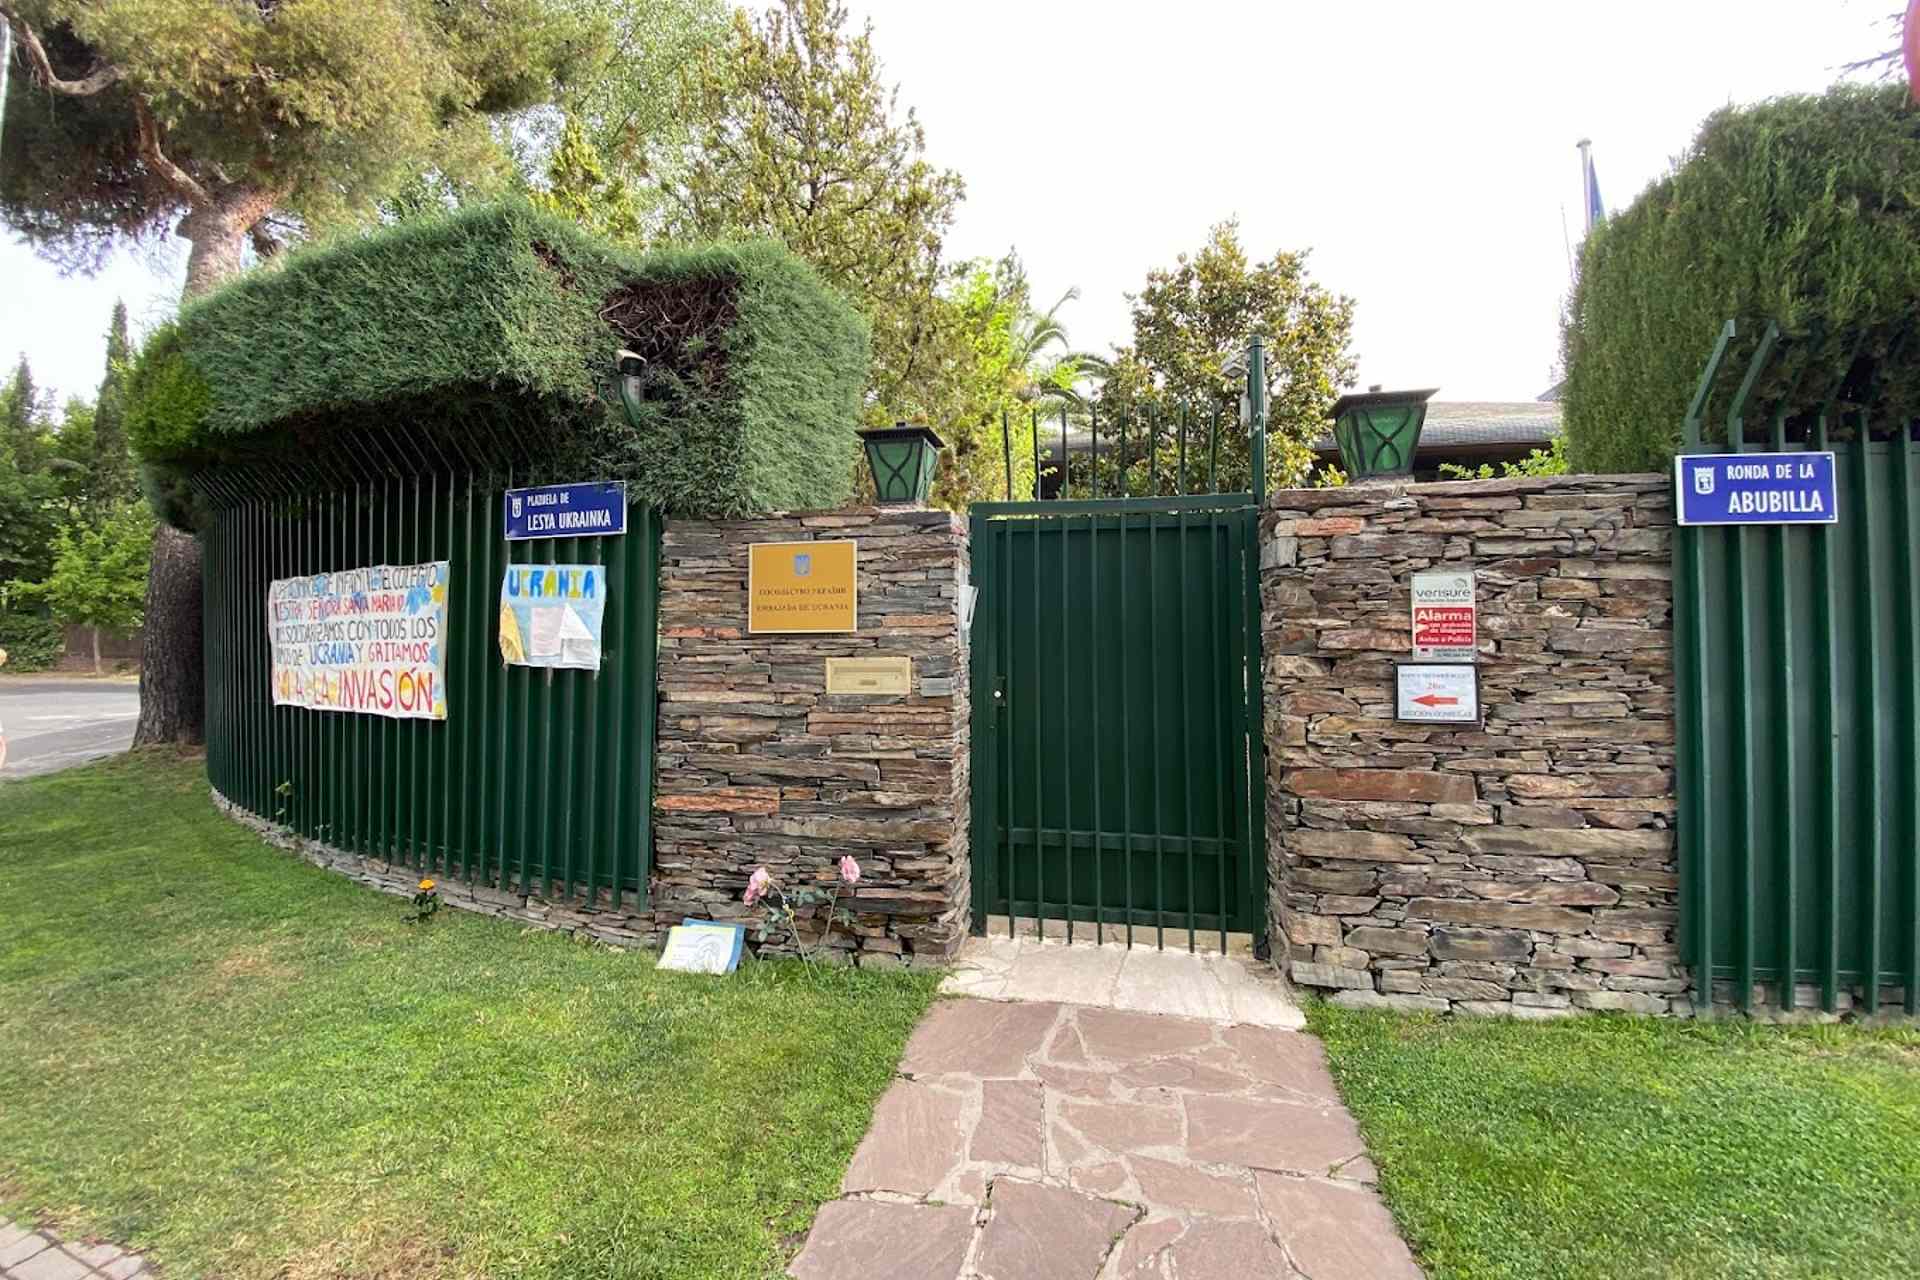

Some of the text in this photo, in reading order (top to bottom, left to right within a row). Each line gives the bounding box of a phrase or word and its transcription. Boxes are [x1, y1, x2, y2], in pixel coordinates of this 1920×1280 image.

[1727, 464, 1815, 480] RONDA DE LA
[527, 491, 569, 507] PLAZUELA DE
[1728, 490, 1824, 513] ABUBILLA
[527, 509, 612, 531] LESYA UKRAINKA
[508, 569, 595, 599] UCRANIA
[1416, 588, 1471, 598] verisure
[1417, 609, 1472, 621] Alarma
[347, 620, 372, 641] CON
[375, 619, 407, 641] TODOS
[411, 617, 436, 639] LOS
[355, 642, 363, 663] Y
[368, 641, 430, 663] GRITAMOS
[338, 667, 433, 713] INVASIÓN
